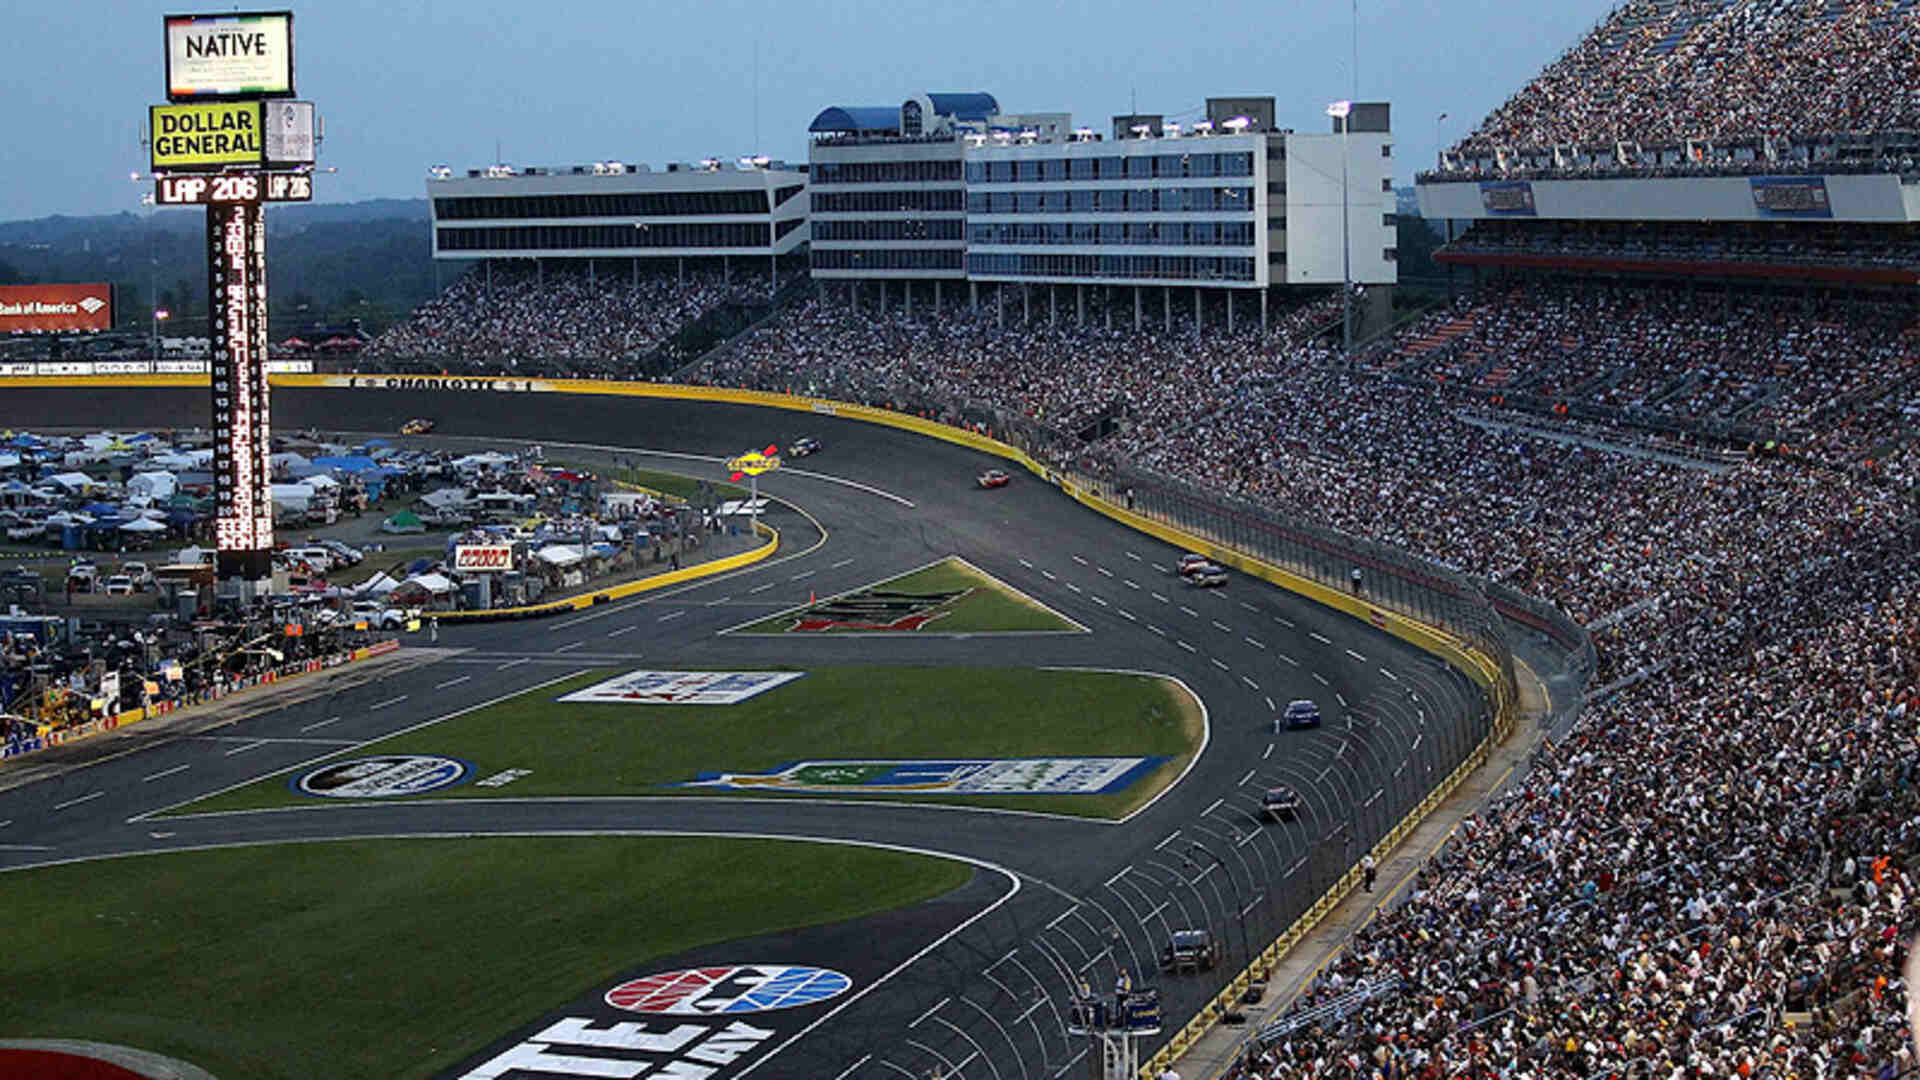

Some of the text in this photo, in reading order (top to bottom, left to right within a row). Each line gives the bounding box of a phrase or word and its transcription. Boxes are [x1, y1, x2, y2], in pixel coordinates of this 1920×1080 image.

[187, 33, 267, 58] NATIVE
[161, 110, 253, 134] DOLLAR
[156, 132, 260, 157] GENERAL
[163, 176, 258, 203] LAP 206
[36, 301, 78, 314] America
[386, 376, 494, 392] CHARLOTTE
